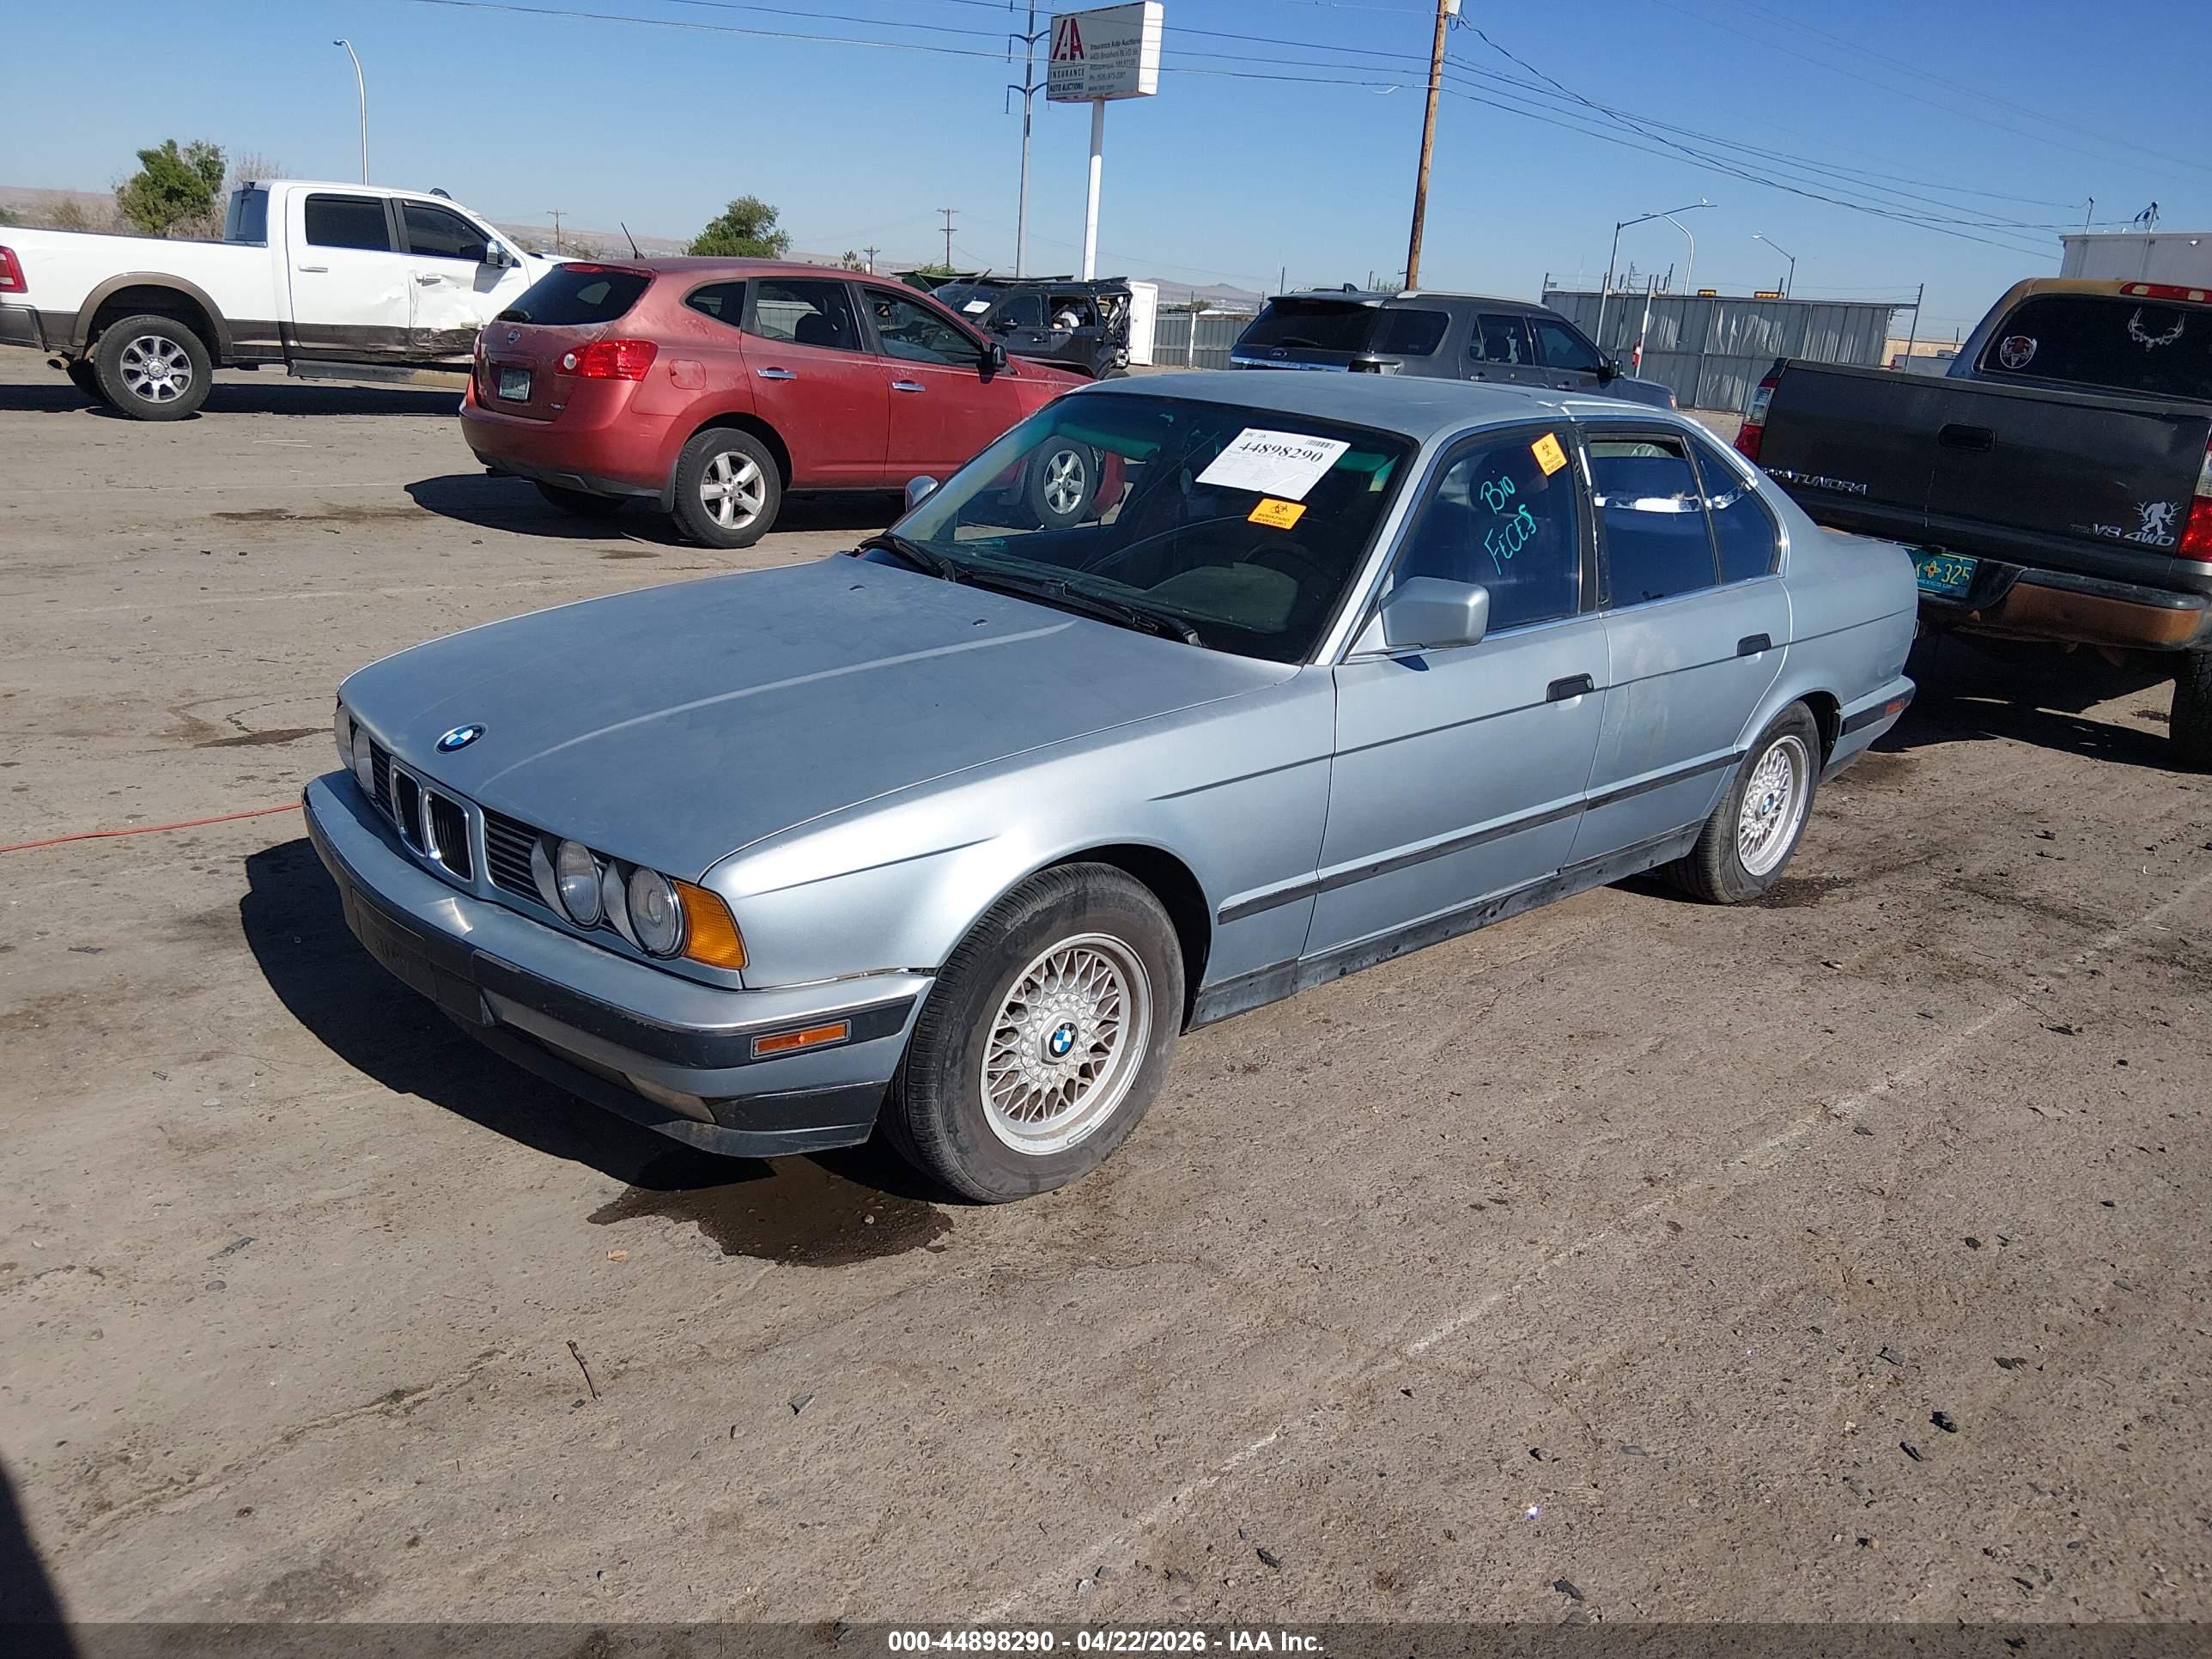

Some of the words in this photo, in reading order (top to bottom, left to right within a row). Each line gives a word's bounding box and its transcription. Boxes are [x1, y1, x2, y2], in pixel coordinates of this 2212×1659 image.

[1050, 69, 1085, 78] INSURANCE
[1062, 82, 1084, 91] AUCTIONS
[1239, 441, 1323, 463] 44898290
[2094, 523, 2122, 538] V8
[2124, 532, 2175, 547] 4WD
